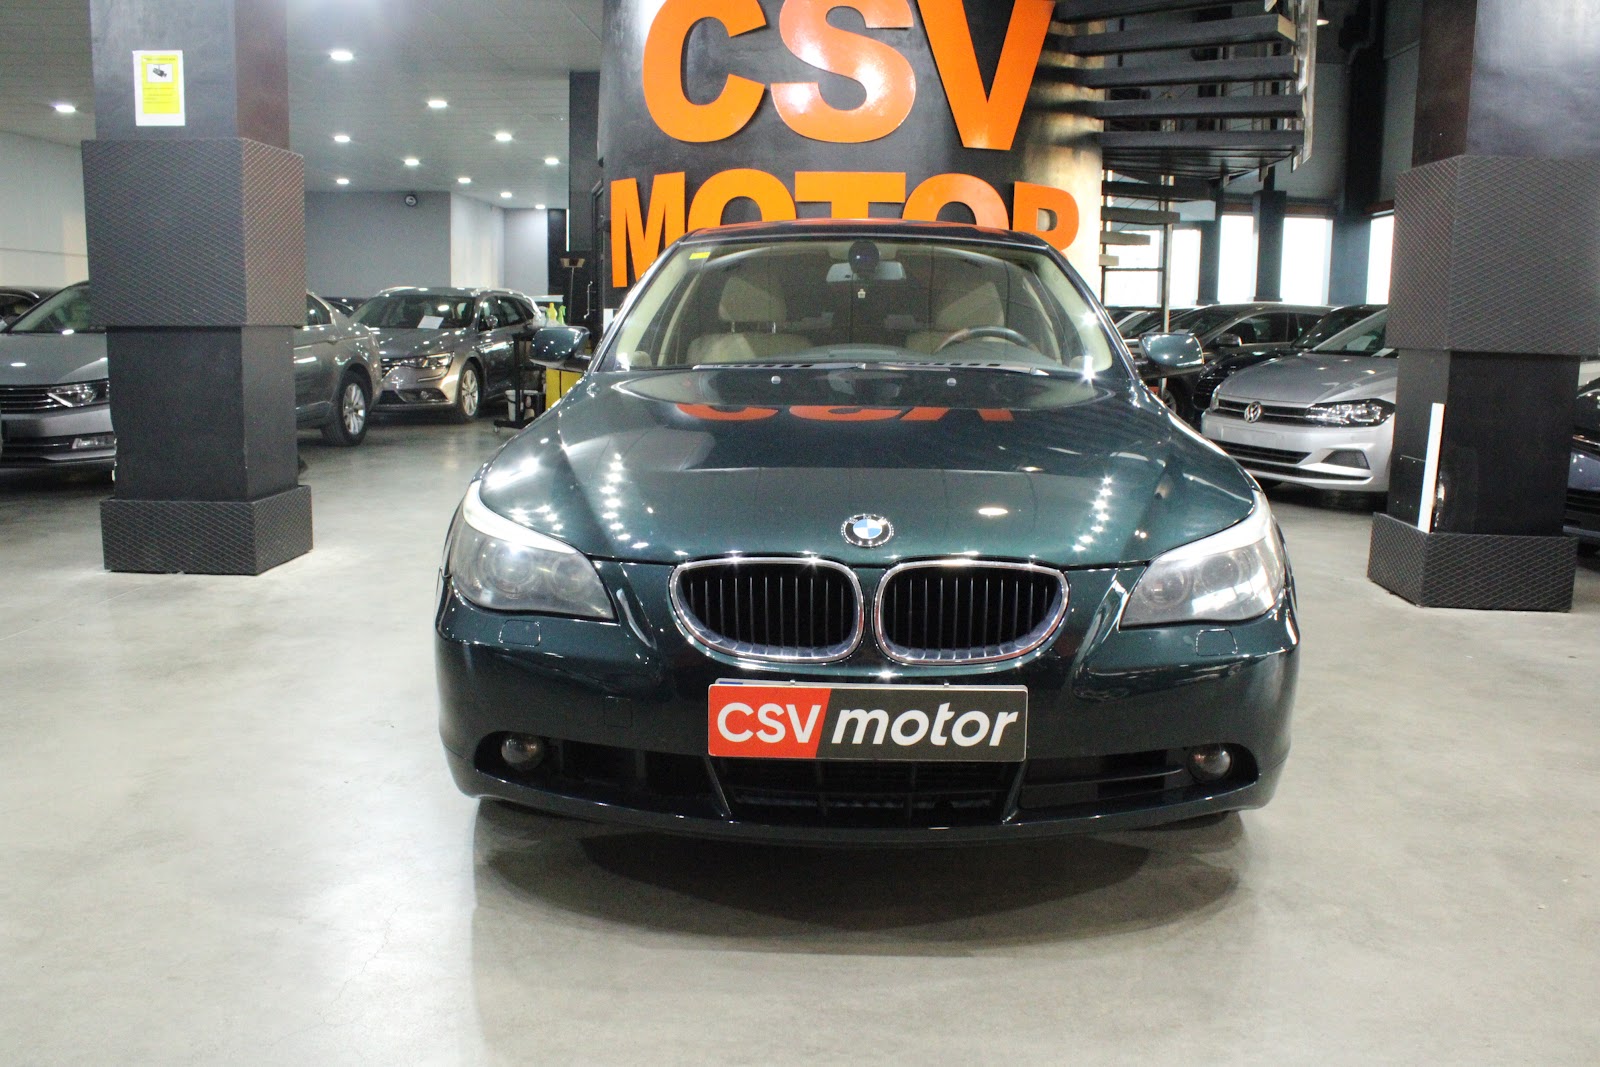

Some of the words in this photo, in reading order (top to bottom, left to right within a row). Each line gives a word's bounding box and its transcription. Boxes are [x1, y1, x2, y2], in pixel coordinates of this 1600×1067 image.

[643, 0, 1054, 151] CSV
[717, 702, 821, 743] CSV
[831, 702, 1018, 747] motor
